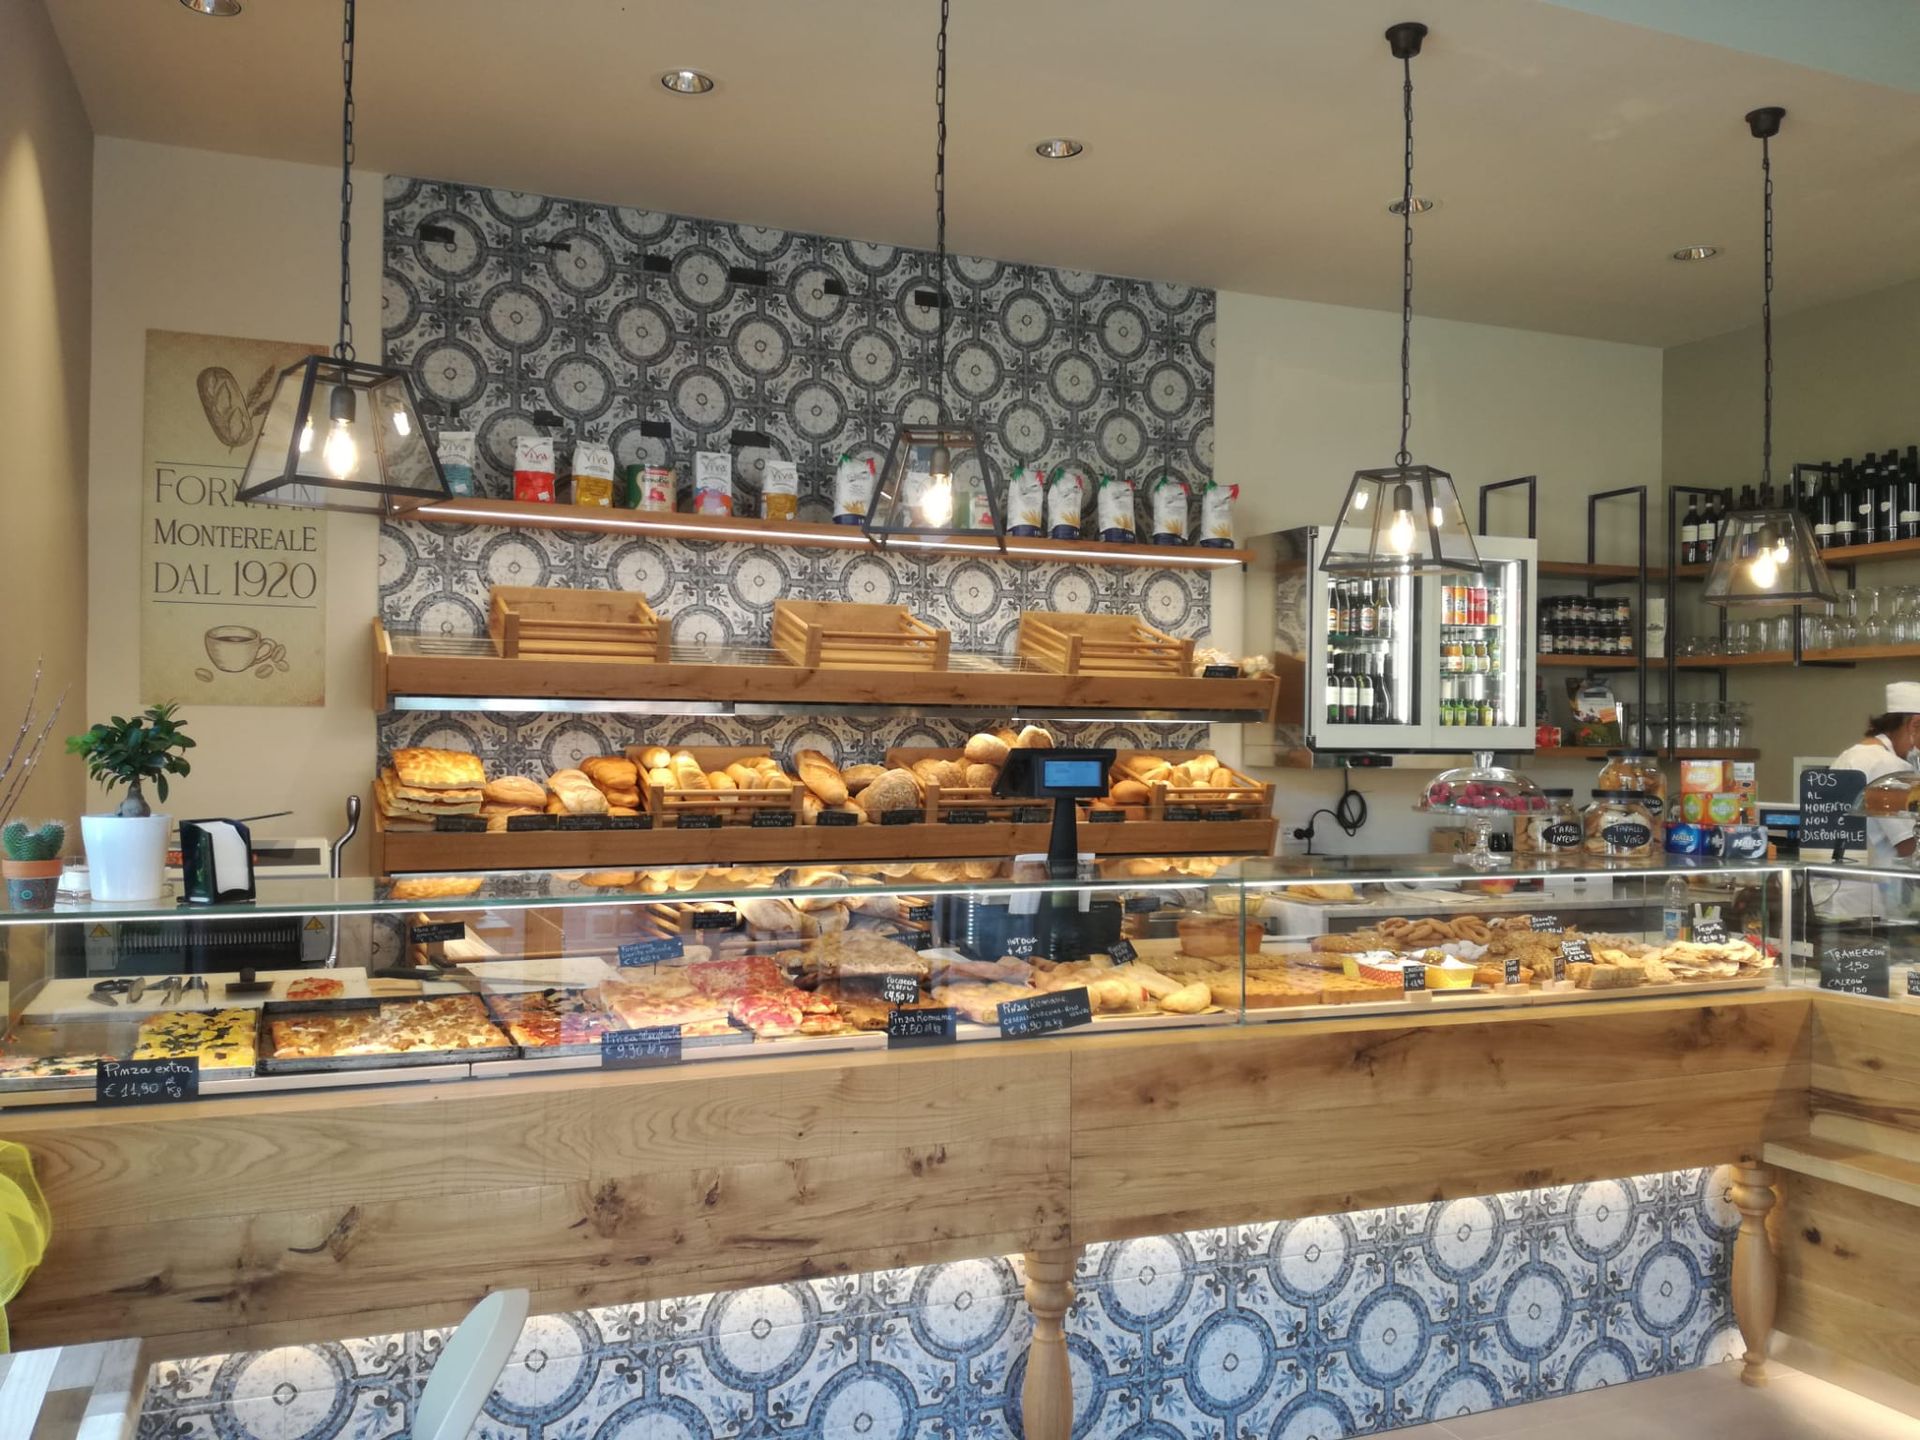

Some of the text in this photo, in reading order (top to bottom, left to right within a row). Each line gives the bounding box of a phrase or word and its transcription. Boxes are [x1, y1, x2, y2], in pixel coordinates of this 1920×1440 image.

[154, 518, 317, 552] MONTEREALE
[154, 560, 317, 599] DAL 1920
[1807, 771, 1837, 787] POS
[1807, 791, 1822, 800] AL
[1805, 816, 1828, 826] NON
[1732, 837, 1762, 849] HALLS
[1801, 828, 1865, 842] DISPONIBILE
[103, 1061, 193, 1078] Pinza extra
[103, 1082, 117, 1098] €
